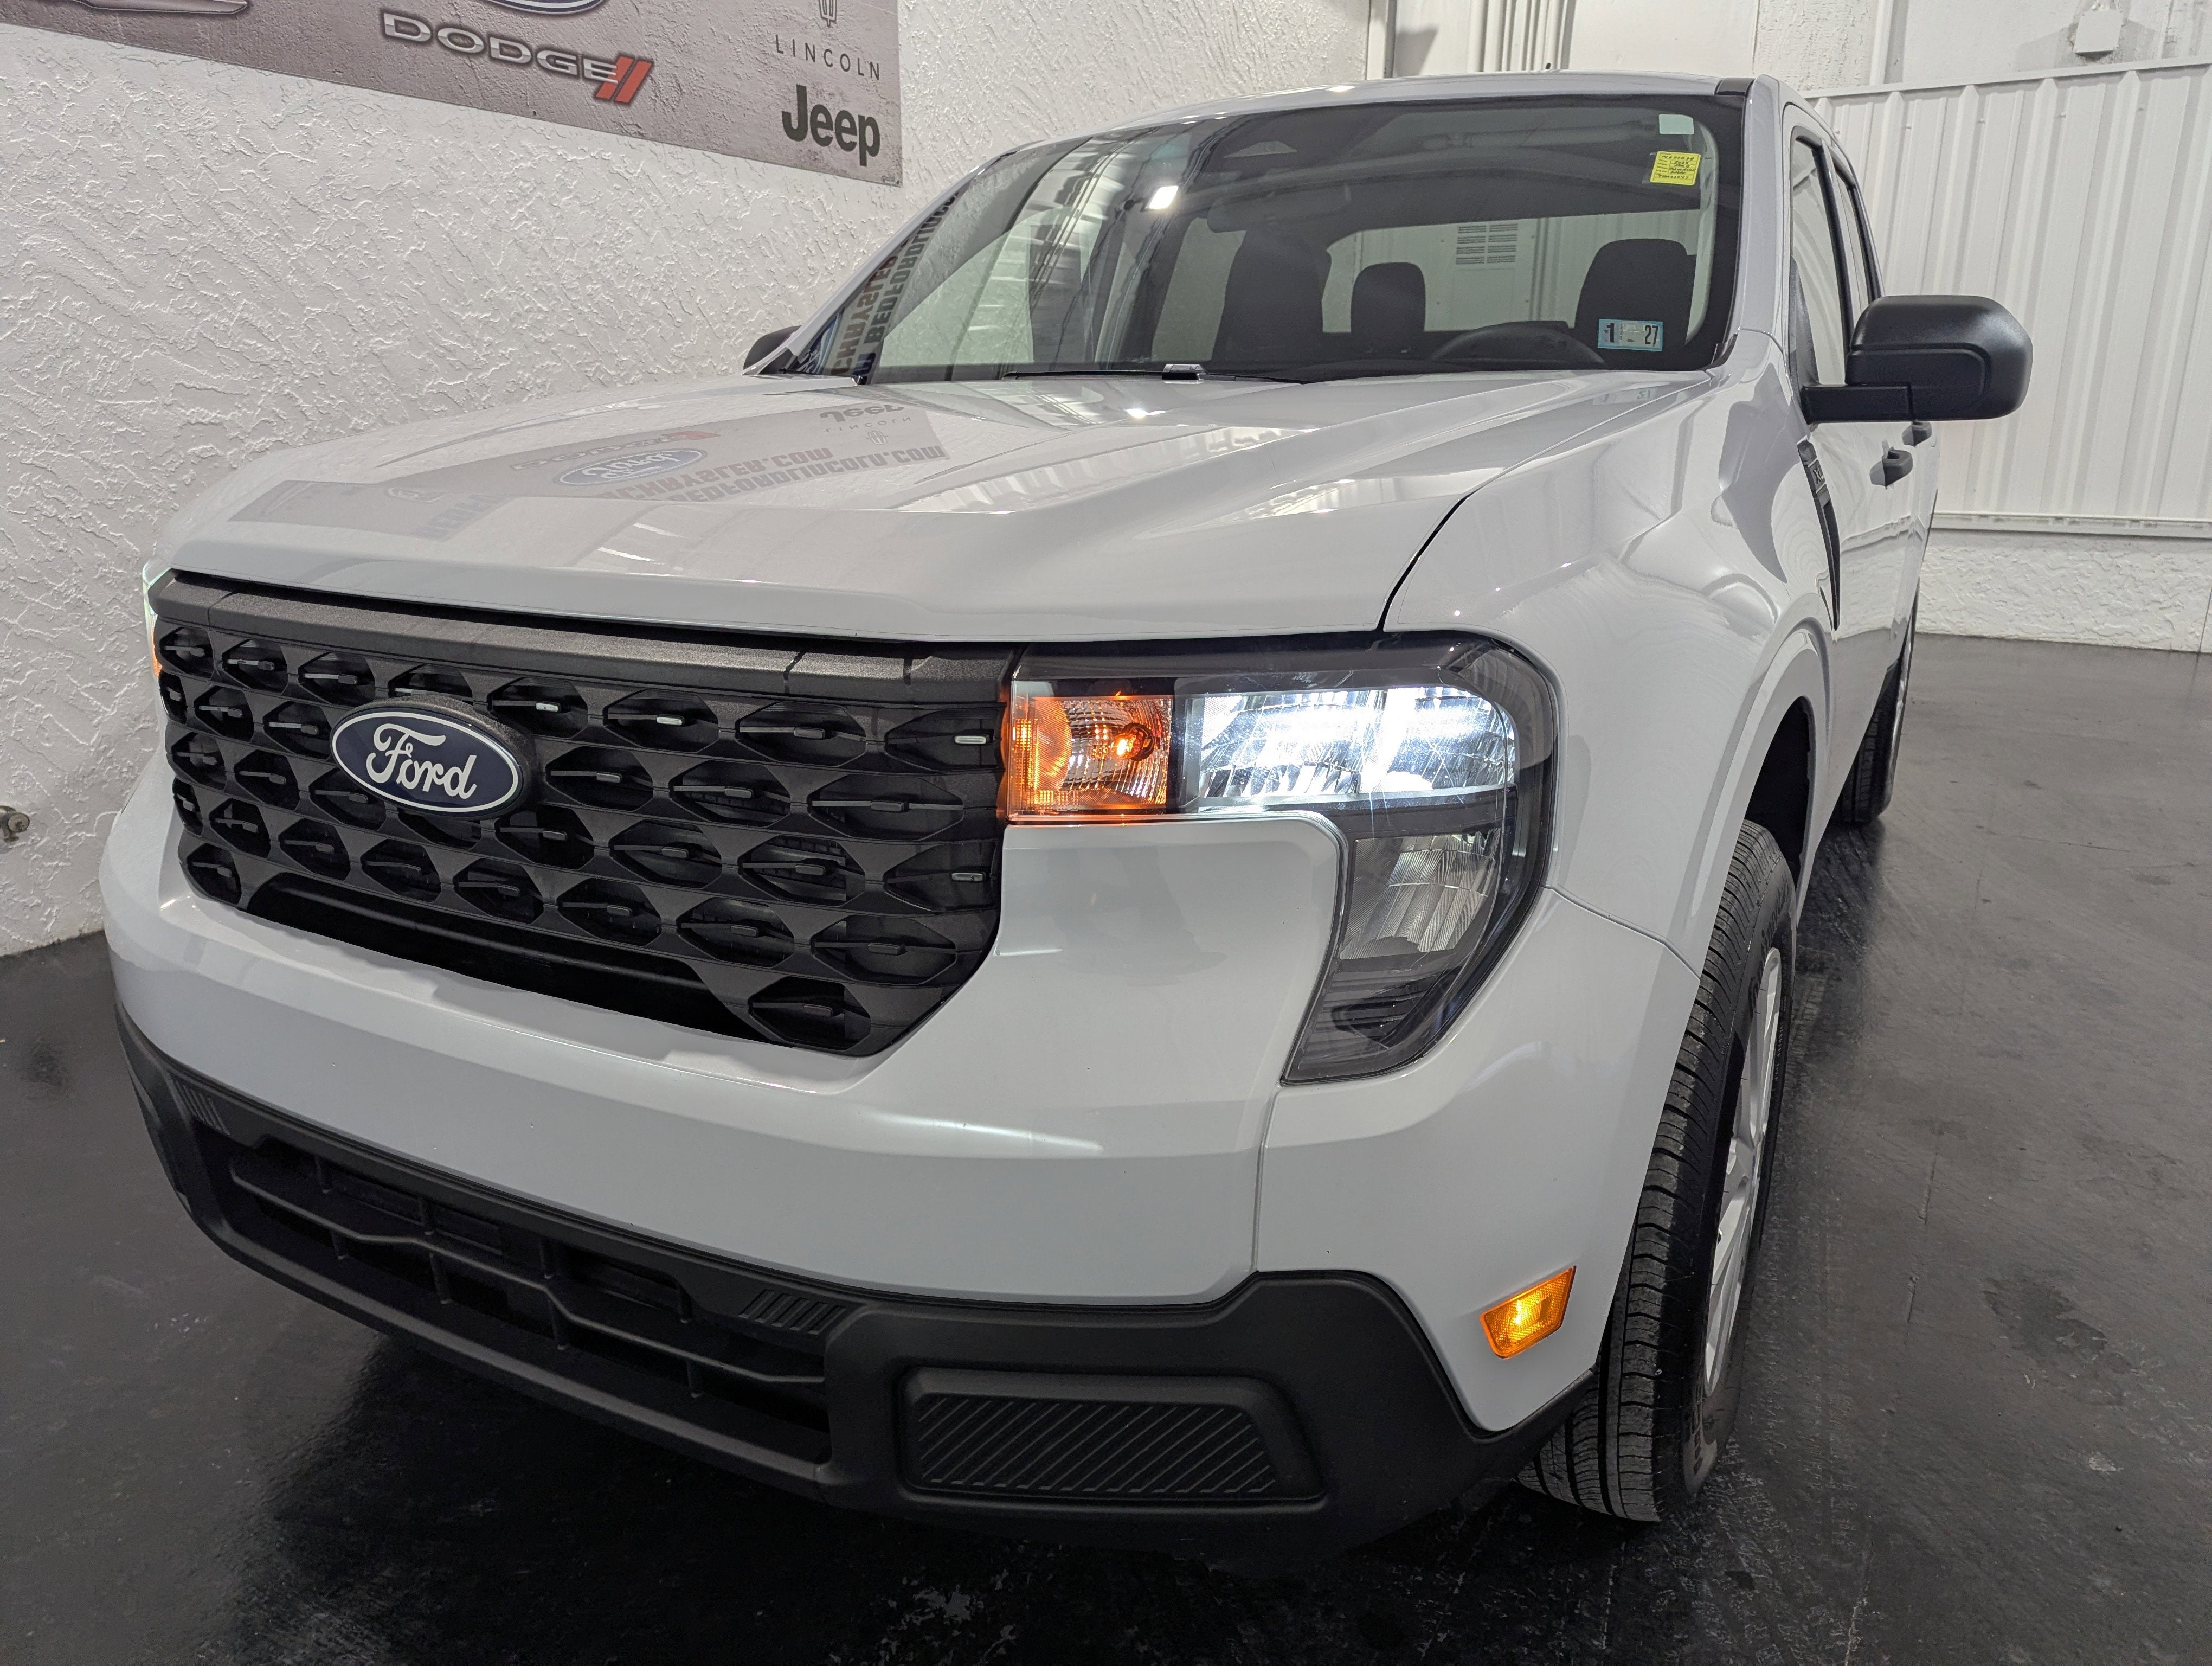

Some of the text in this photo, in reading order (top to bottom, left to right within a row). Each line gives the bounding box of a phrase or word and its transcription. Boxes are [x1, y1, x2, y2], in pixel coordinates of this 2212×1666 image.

[383, 12, 619, 84] DODGE
[776, 34, 879, 80] LINCOLN
[782, 84, 880, 167] Jeep
[1606, 323, 1614, 343] 1
[1645, 325, 1658, 345] 27
[366, 723, 477, 800] Ford
